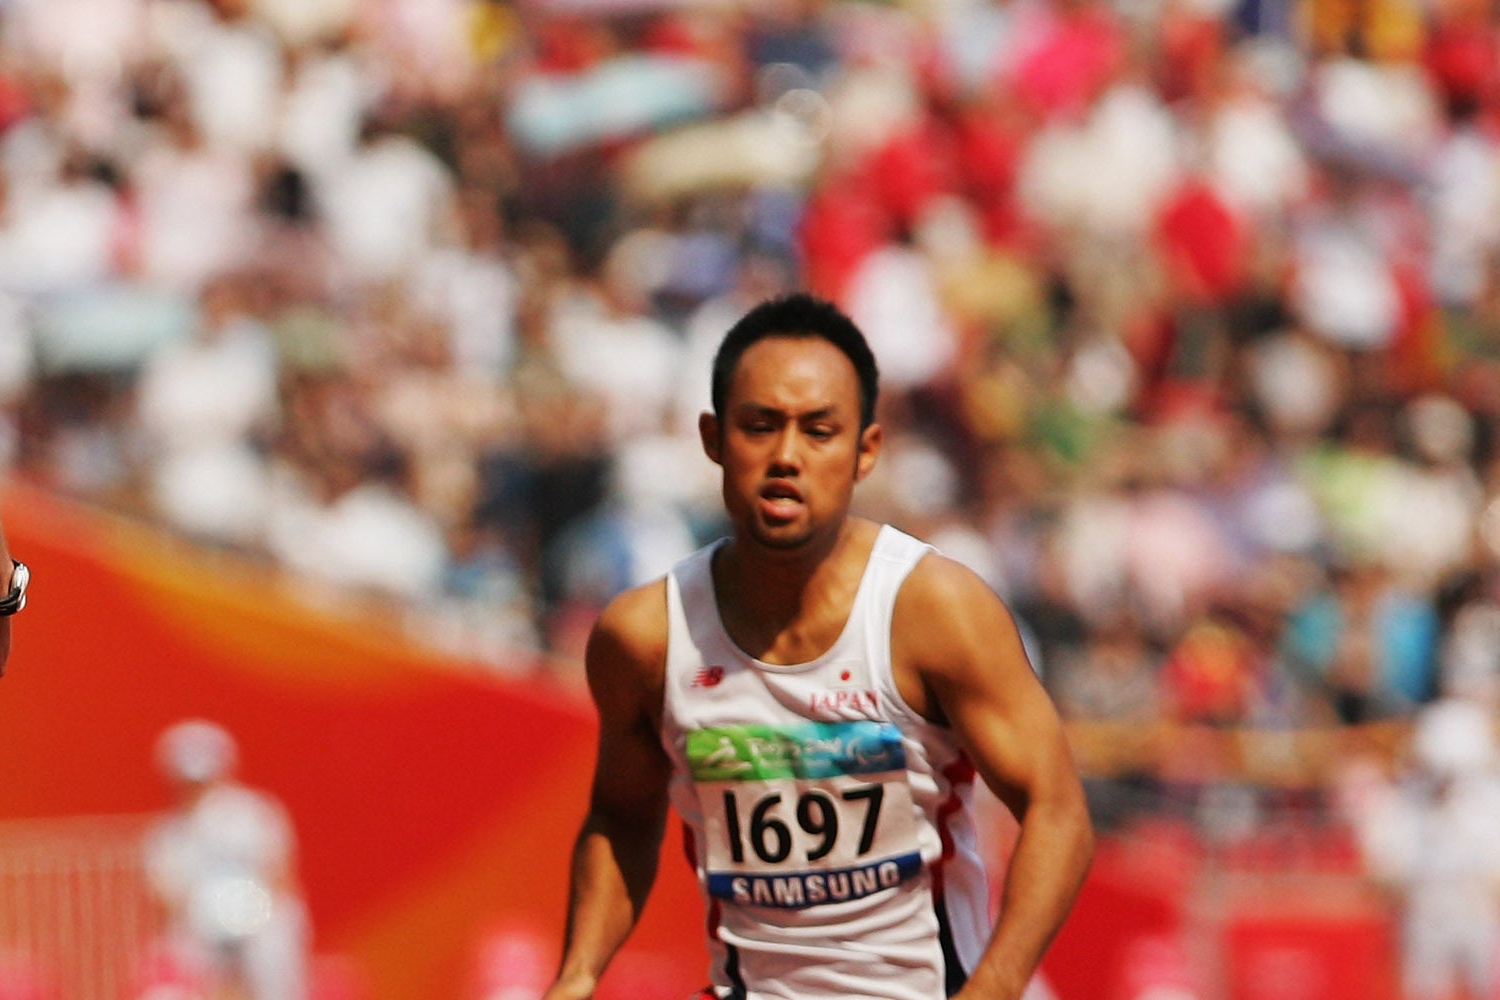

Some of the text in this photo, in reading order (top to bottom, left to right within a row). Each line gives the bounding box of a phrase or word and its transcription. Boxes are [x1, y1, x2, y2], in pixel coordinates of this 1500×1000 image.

[808, 690, 879, 713] JAPAN
[723, 783, 884, 864] 1697
[731, 861, 900, 906] SAMSUNG
